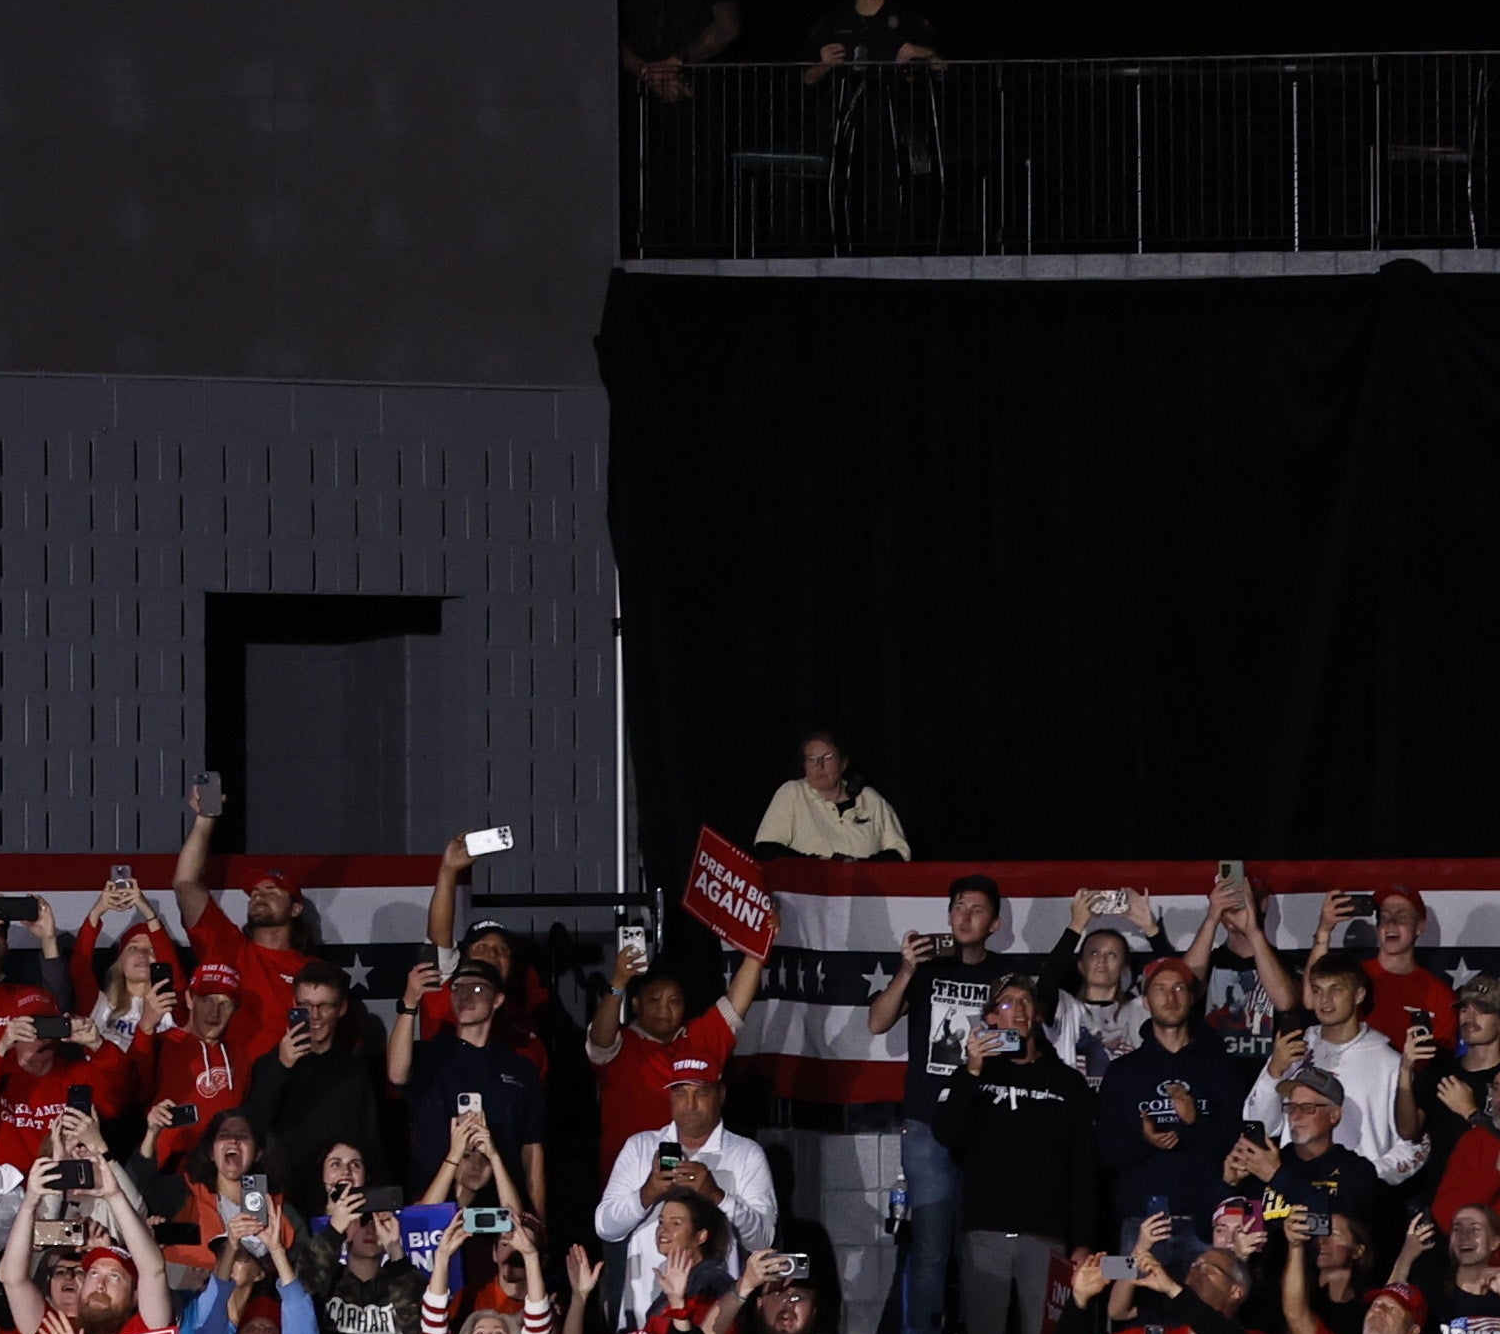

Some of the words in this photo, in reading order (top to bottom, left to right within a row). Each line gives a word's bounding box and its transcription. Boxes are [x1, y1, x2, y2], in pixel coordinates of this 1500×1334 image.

[698, 849, 746, 892] DREAM
[693, 870, 766, 934] AGAIN!
[933, 979, 989, 1003] TRUM
[673, 1058, 708, 1071] TRUMP
[0, 1111, 44, 1130] GREAT
